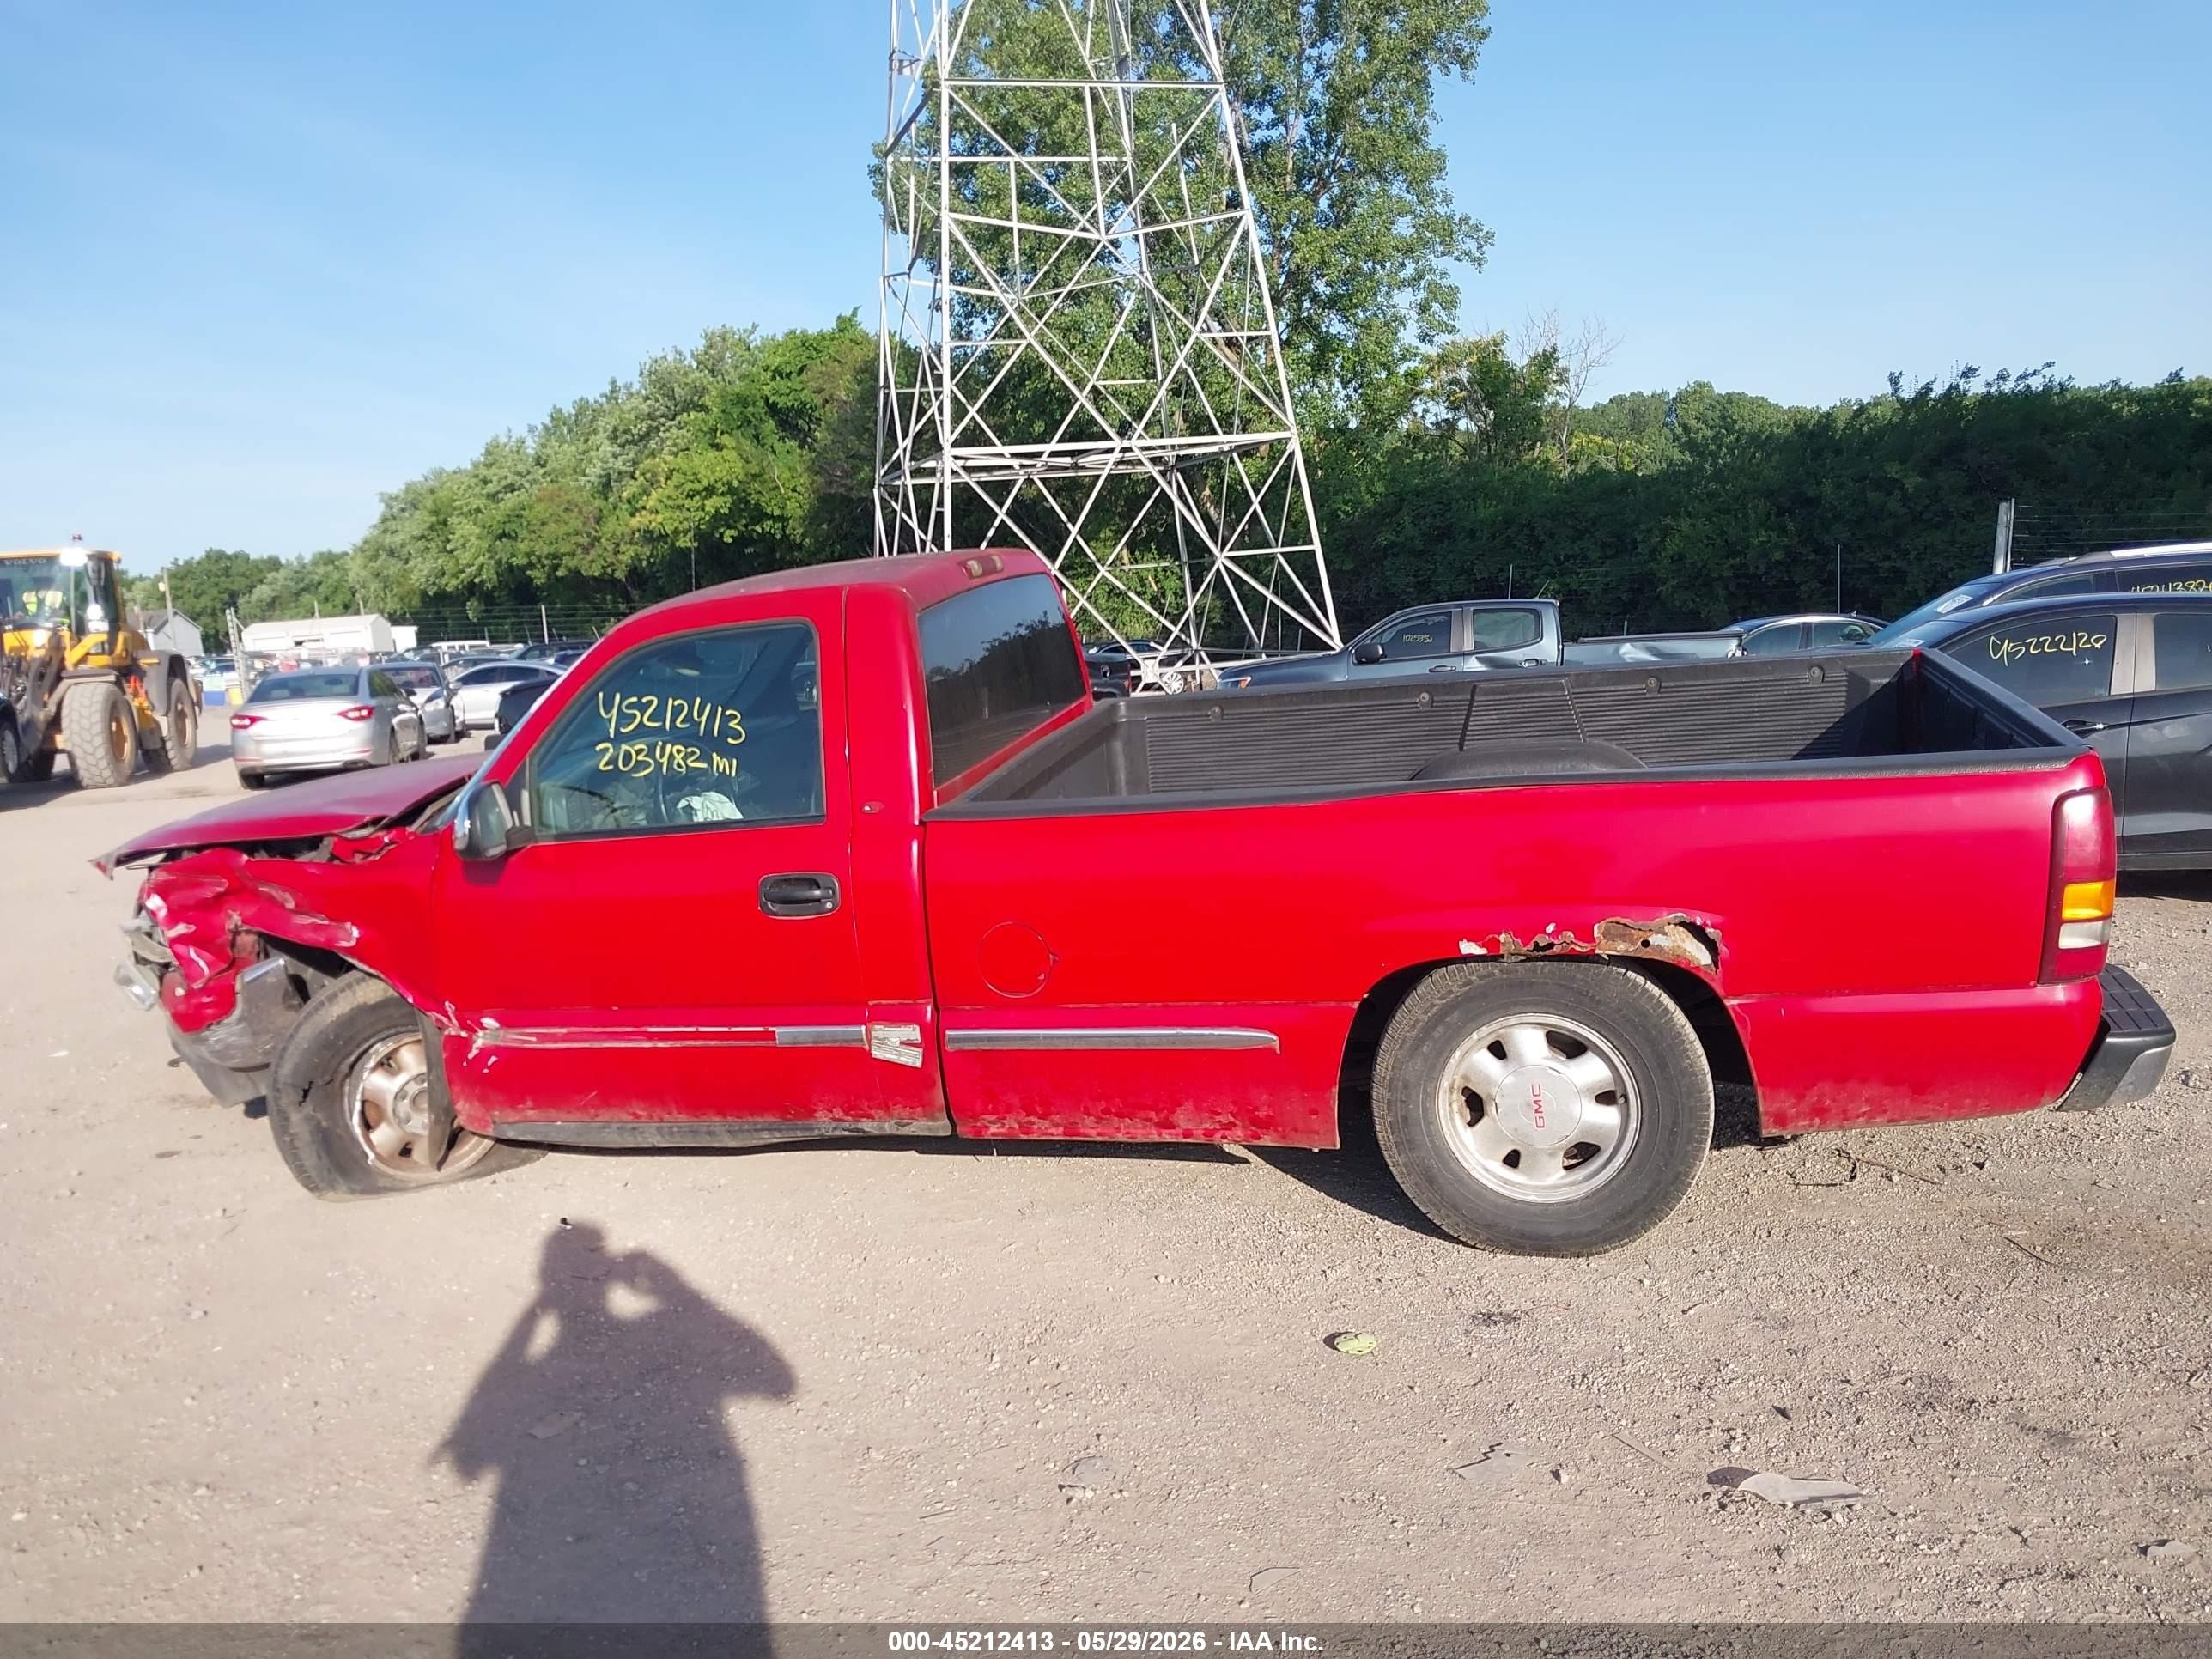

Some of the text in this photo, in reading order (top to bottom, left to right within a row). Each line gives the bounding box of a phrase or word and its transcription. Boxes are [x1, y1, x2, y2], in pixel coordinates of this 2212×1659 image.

[597, 690, 746, 744] 45212413
[595, 741, 708, 777] 203482
[1531, 1083, 1546, 1131] GMC
